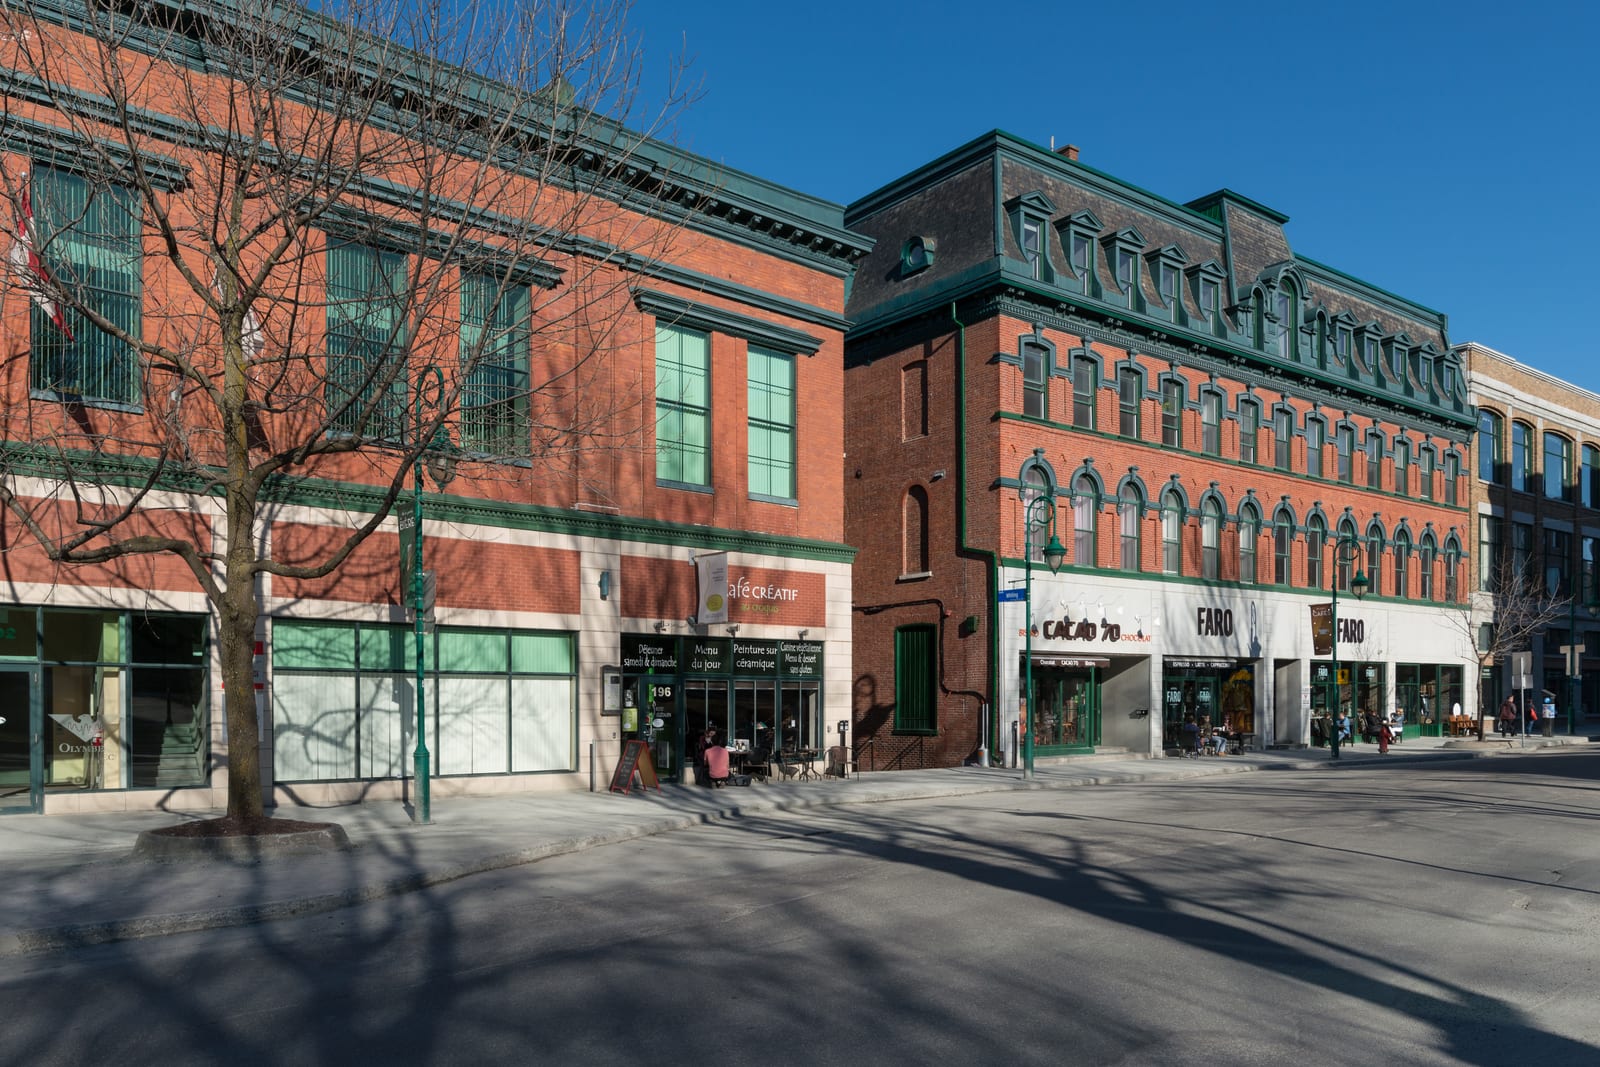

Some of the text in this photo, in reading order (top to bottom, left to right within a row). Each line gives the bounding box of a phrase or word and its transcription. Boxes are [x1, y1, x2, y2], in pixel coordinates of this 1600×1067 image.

[727, 576, 799, 600] afé CRÉATIF
[1197, 607, 1233, 637] FARO
[1043, 620, 1097, 642] CACAO
[1101, 623, 1121, 642] 70
[1337, 618, 1365, 644] FARO
[695, 644, 719, 655] Menu
[733, 643, 778, 655] Peinture sur
[624, 655, 643, 667] samedi
[650, 655, 678, 667] dimanche
[691, 658, 722, 671] du jour
[736, 658, 775, 671] céramique
[651, 686, 672, 697] 196
[1167, 691, 1181, 702] FARO
